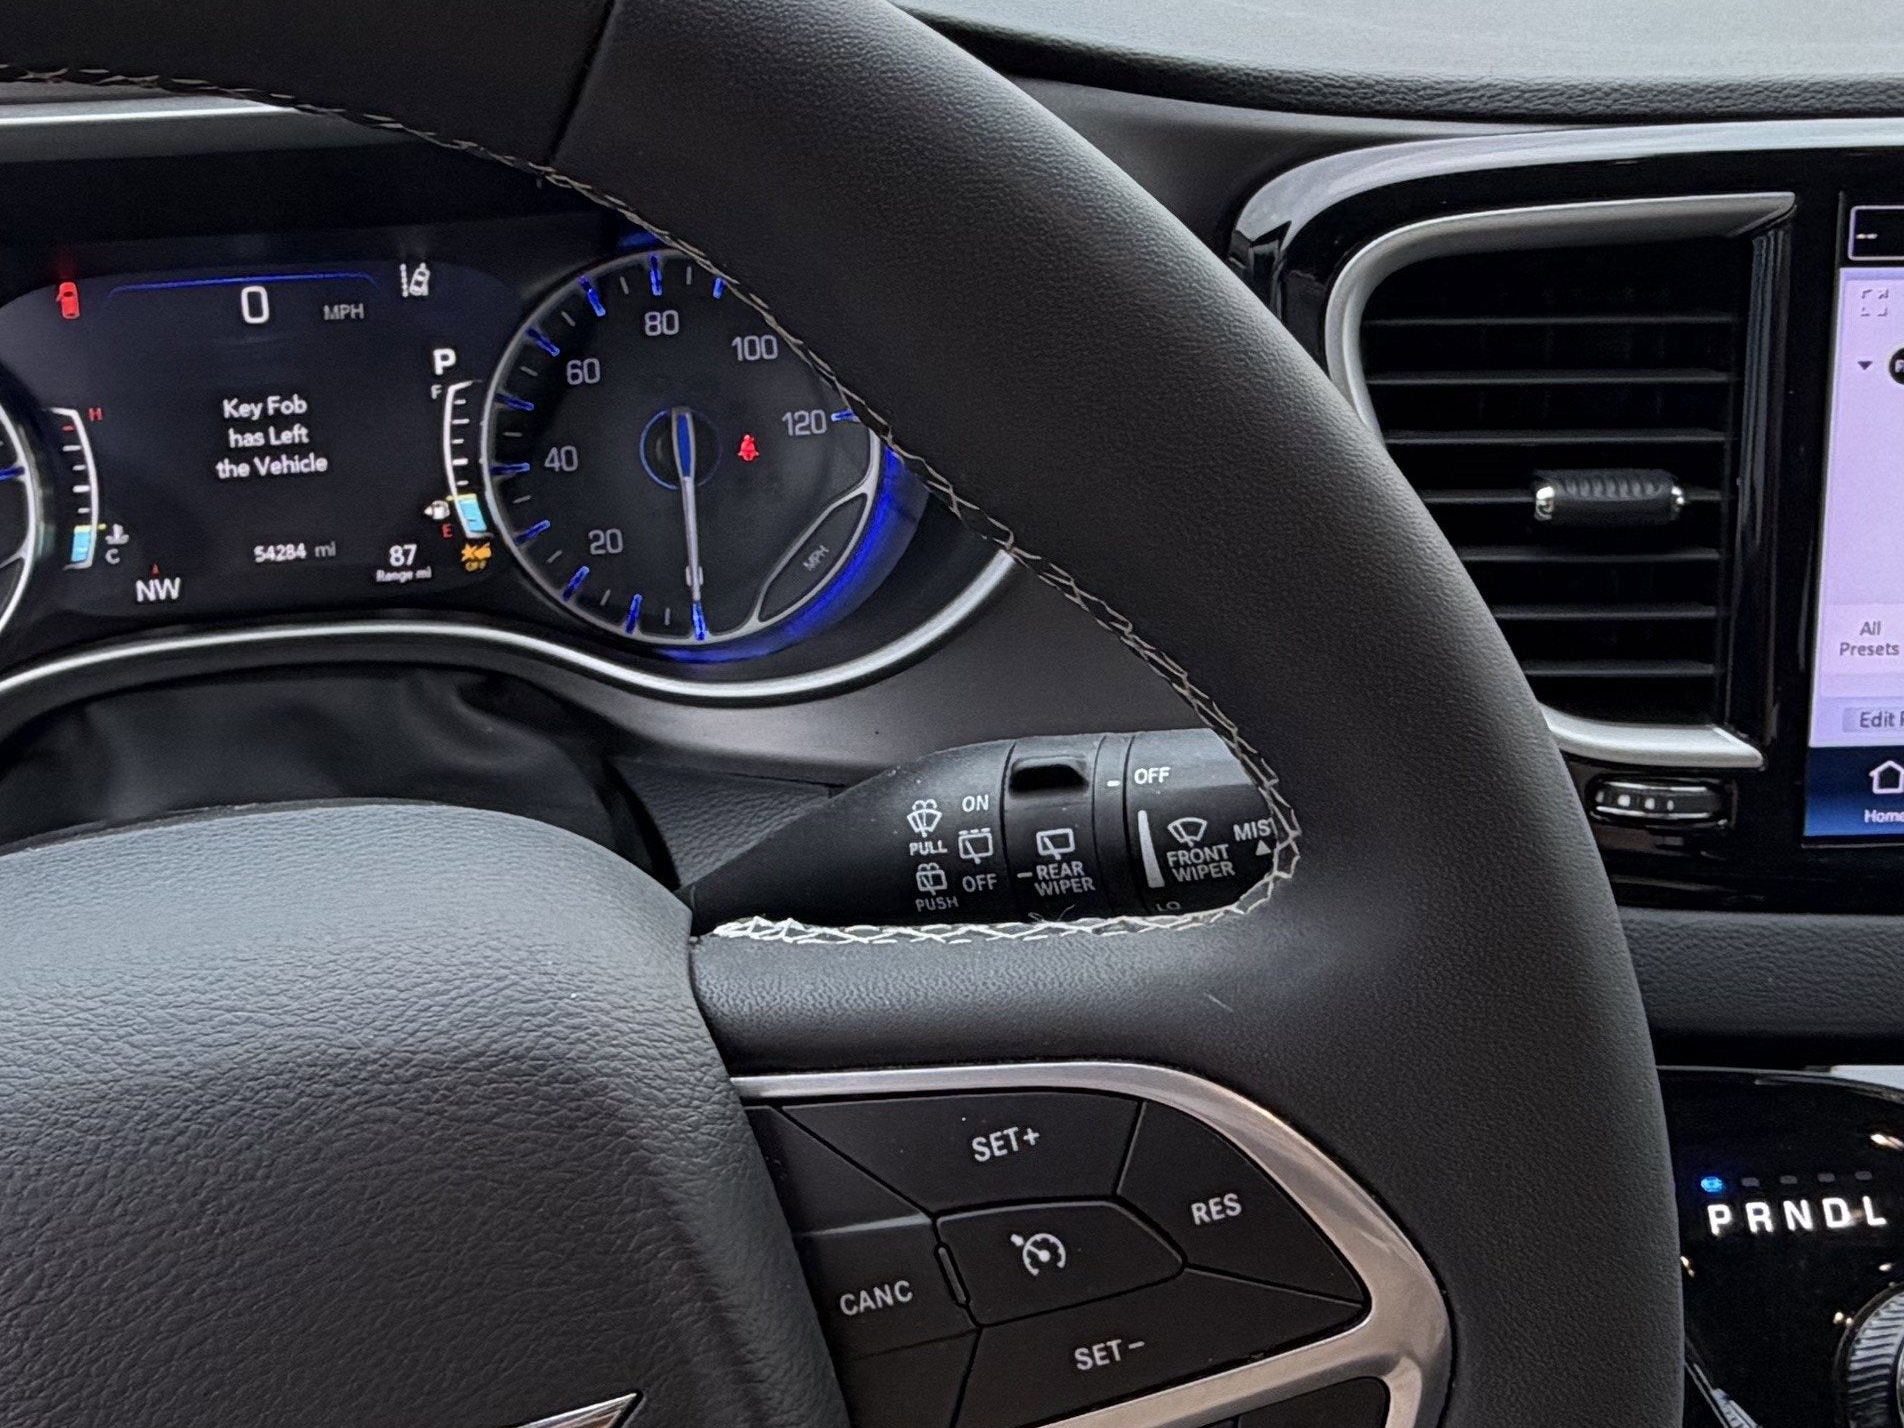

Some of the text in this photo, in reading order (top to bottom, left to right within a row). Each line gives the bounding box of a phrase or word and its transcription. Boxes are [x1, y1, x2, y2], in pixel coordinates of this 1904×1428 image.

[240, 286, 365, 324] 0 MPH
[644, 310, 679, 336] 80
[731, 335, 778, 361] 100
[433, 348, 456, 376] P
[566, 358, 601, 385] 60
[431, 384, 443, 399] F
[88, 408, 103, 422] H
[222, 395, 308, 420] Key Fob
[782, 409, 827, 436] 120
[228, 426, 309, 448] has Left
[215, 454, 328, 479] the Vehicle
[544, 445, 578, 472] 40
[442, 524, 453, 539] E
[588, 528, 623, 555] 20
[106, 548, 119, 565] C
[253, 541, 336, 563] 54284 mi
[389, 545, 417, 567] 87
[802, 544, 831, 572] MPH
[135, 578, 181, 602] NW
[1859, 620, 1881, 635] All
[1839, 641, 1900, 657] Presets
[1859, 710, 1896, 728] Edit
[1133, 766, 1171, 786] OFF
[961, 794, 990, 814] ON
[909, 841, 948, 857] PULL
[1166, 844, 1229, 868] FRONT
[1036, 861, 1085, 879] REAR
[1172, 861, 1236, 883] WIPER
[963, 873, 998, 893] OFF
[1034, 876, 1096, 898] WIPER
[915, 896, 959, 912] PUSH
[1155, 900, 1182, 913] LO
[971, 1126, 1041, 1163] SET+
[1190, 1193, 1243, 1226] RES
[839, 1279, 914, 1316] CANC
